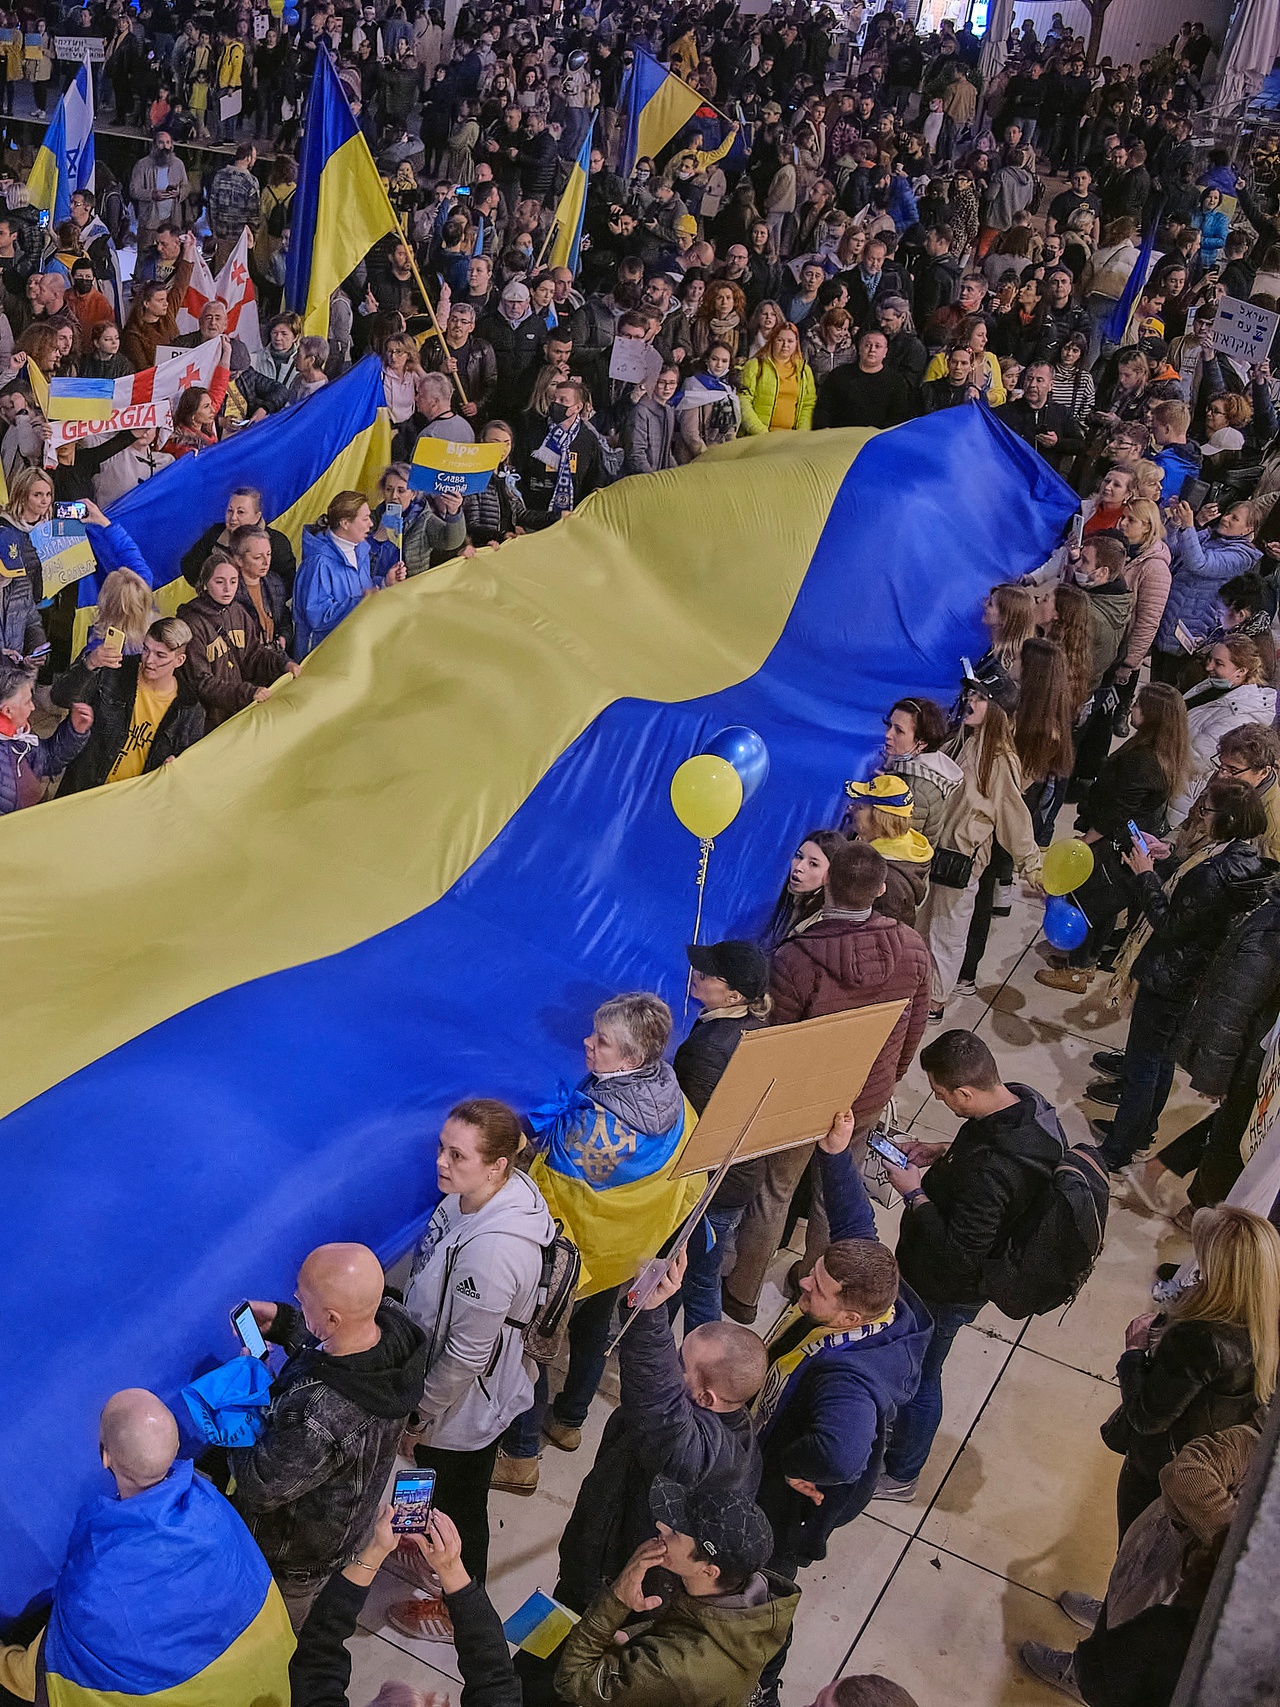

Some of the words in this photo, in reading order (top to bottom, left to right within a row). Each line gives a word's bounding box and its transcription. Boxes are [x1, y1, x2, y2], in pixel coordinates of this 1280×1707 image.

[1237, 320, 1252, 333] עם
[61, 404, 157, 441] GEORGIA
[455, 1284, 481, 1300] adidas
